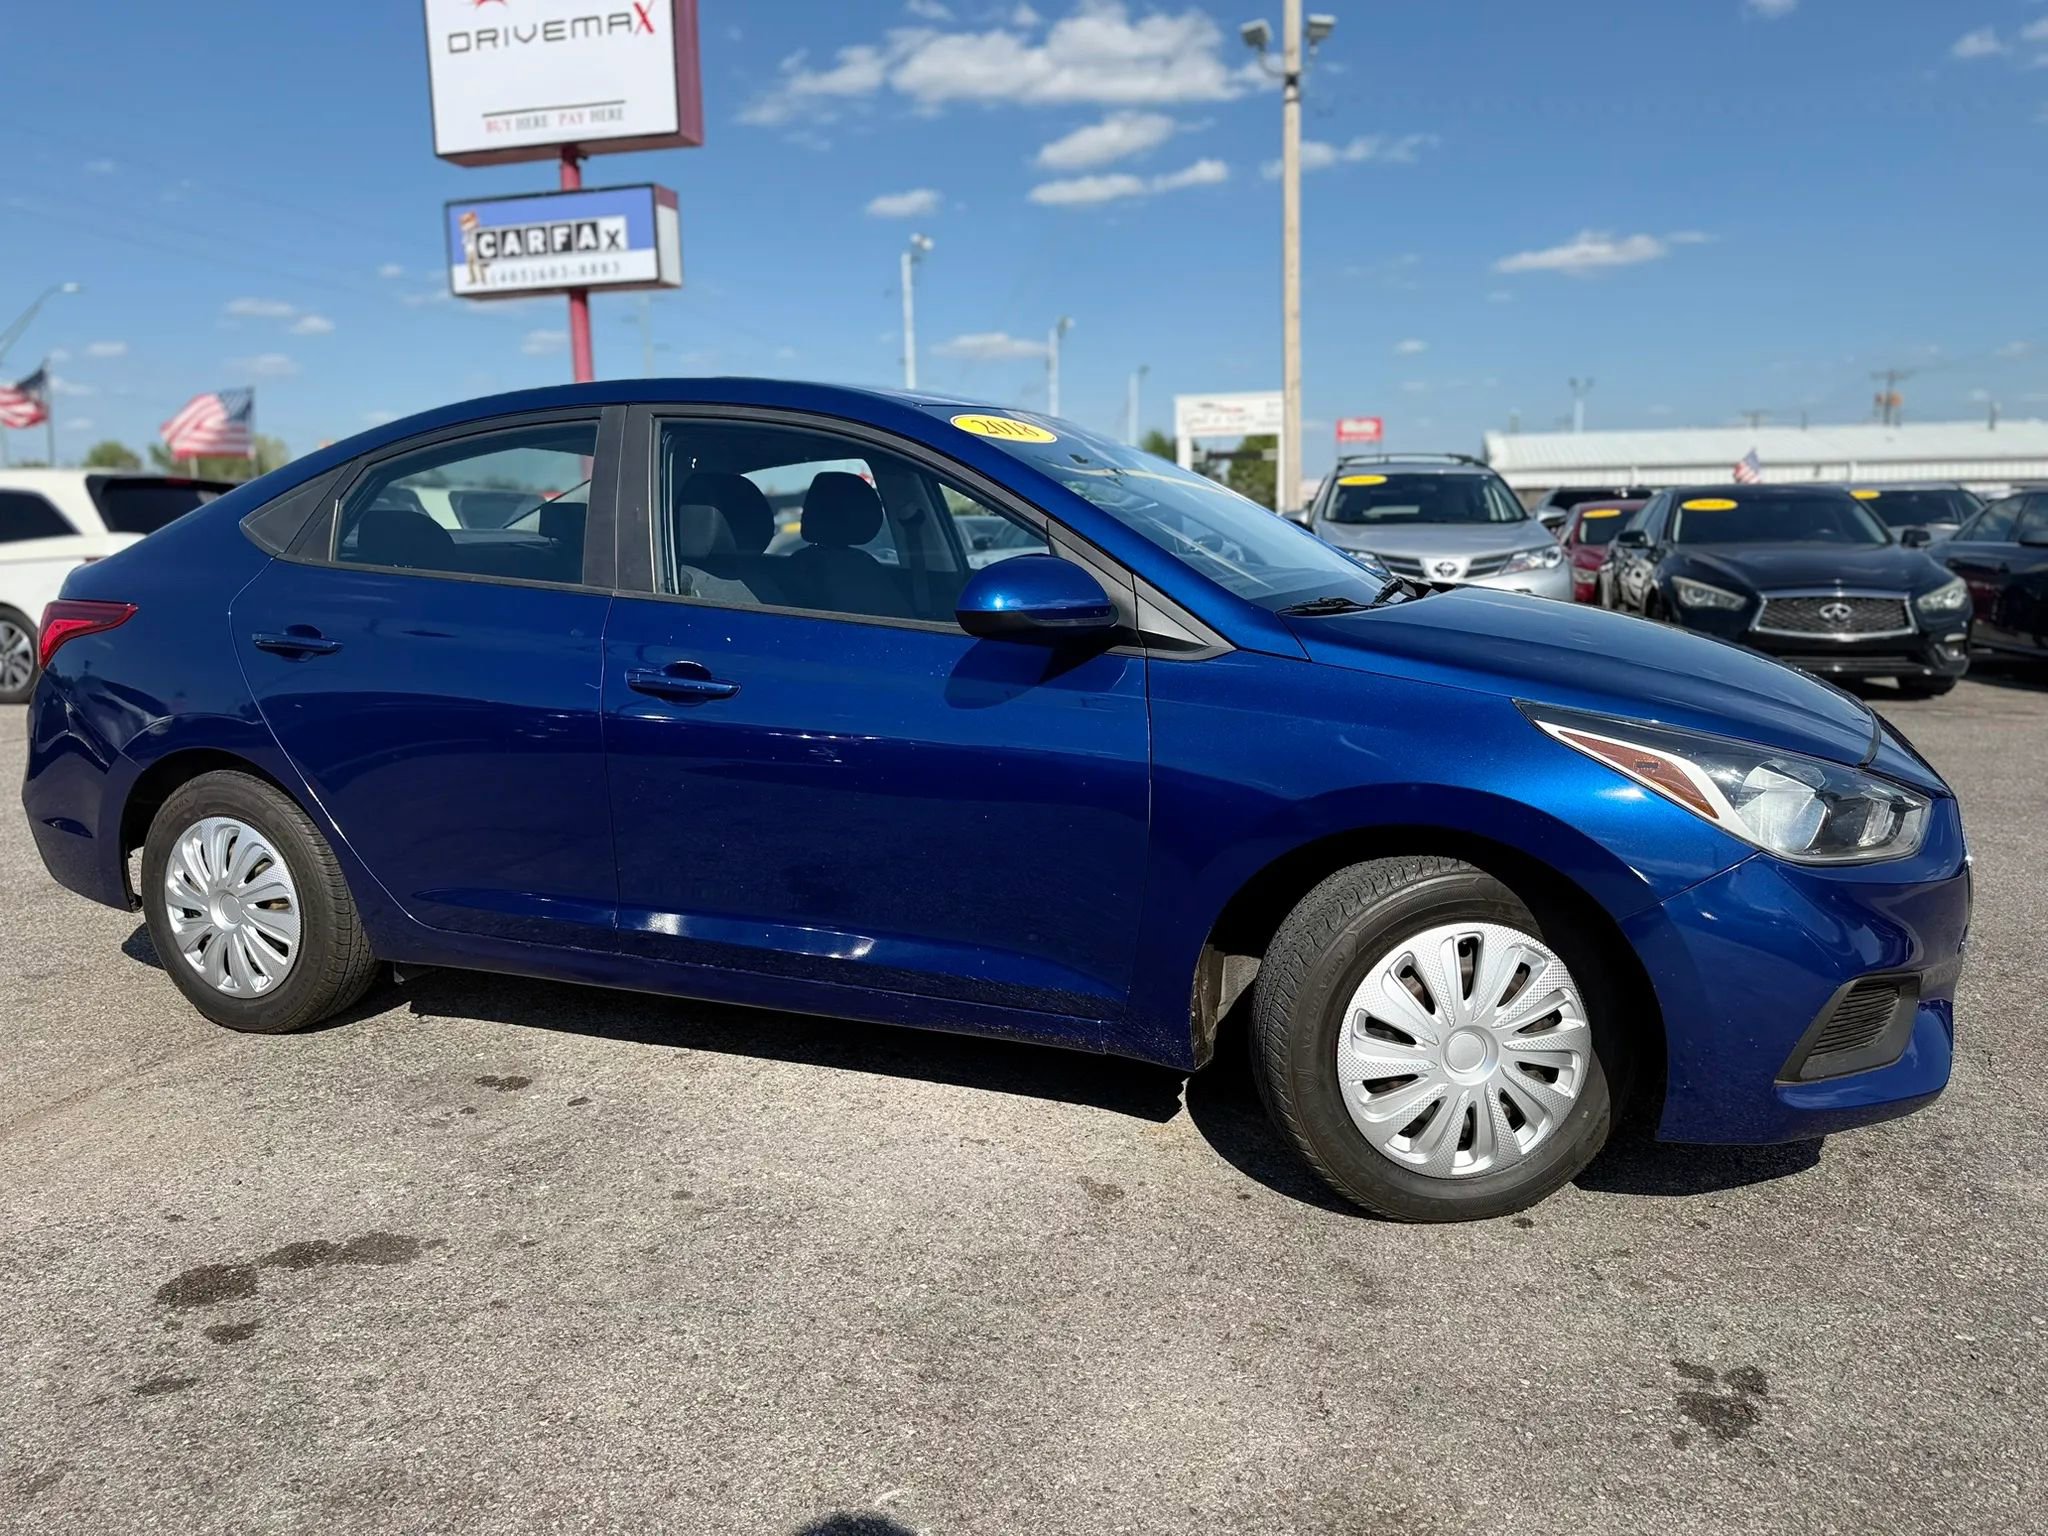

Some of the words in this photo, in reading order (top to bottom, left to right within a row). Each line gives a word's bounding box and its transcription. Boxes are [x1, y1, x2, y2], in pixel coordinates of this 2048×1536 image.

[447, 2, 654, 54] DRIVEMAX
[485, 119, 512, 133] BUY
[515, 114, 548, 131] HERE
[558, 111, 584, 126] PAY
[589, 107, 624, 123] HERE
[476, 221, 623, 259] CARFAX
[971, 419, 1039, 437] 2018
